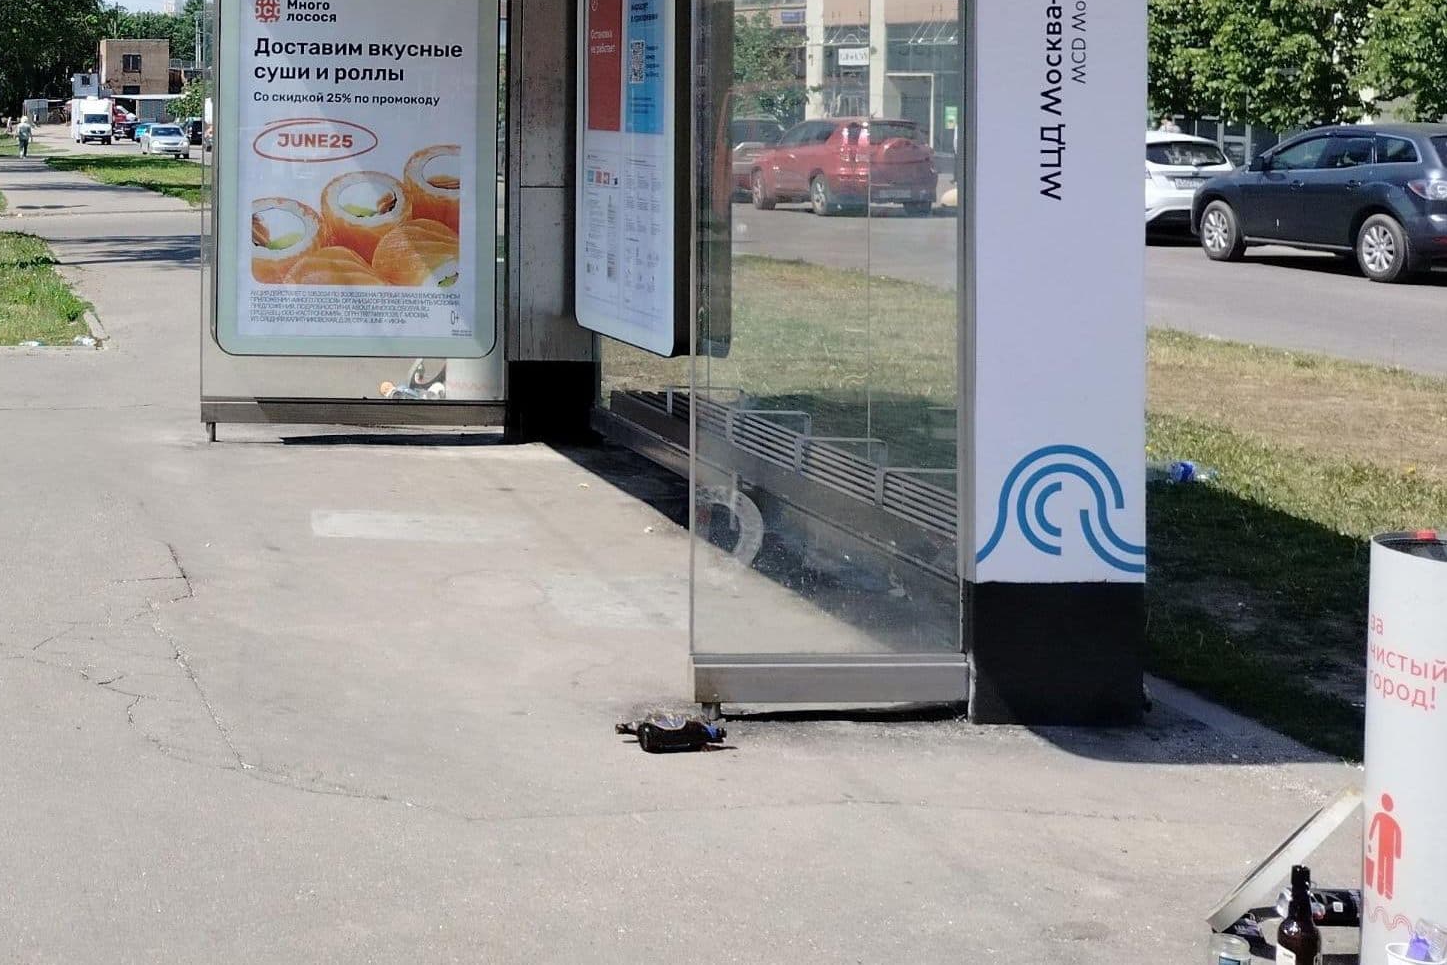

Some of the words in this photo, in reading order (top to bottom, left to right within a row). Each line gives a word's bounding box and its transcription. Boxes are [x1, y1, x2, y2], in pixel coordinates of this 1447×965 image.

[286, 13, 337, 22] лосося
[254, 38, 363, 58] Доставим
[368, 43, 464, 60] вкусные
[1071, 37, 1087, 85] MCD
[254, 66, 310, 83] суши
[316, 68, 329, 80] и
[334, 68, 404, 84] роллы
[254, 92, 270, 102] Со
[272, 92, 324, 103] скидкой
[326, 93, 352, 104] 25%
[354, 94, 370, 104] по
[372, 95, 440, 106] промокоду
[277, 134, 354, 149] JUNE25
[1040, 123, 1066, 201] МЦД
